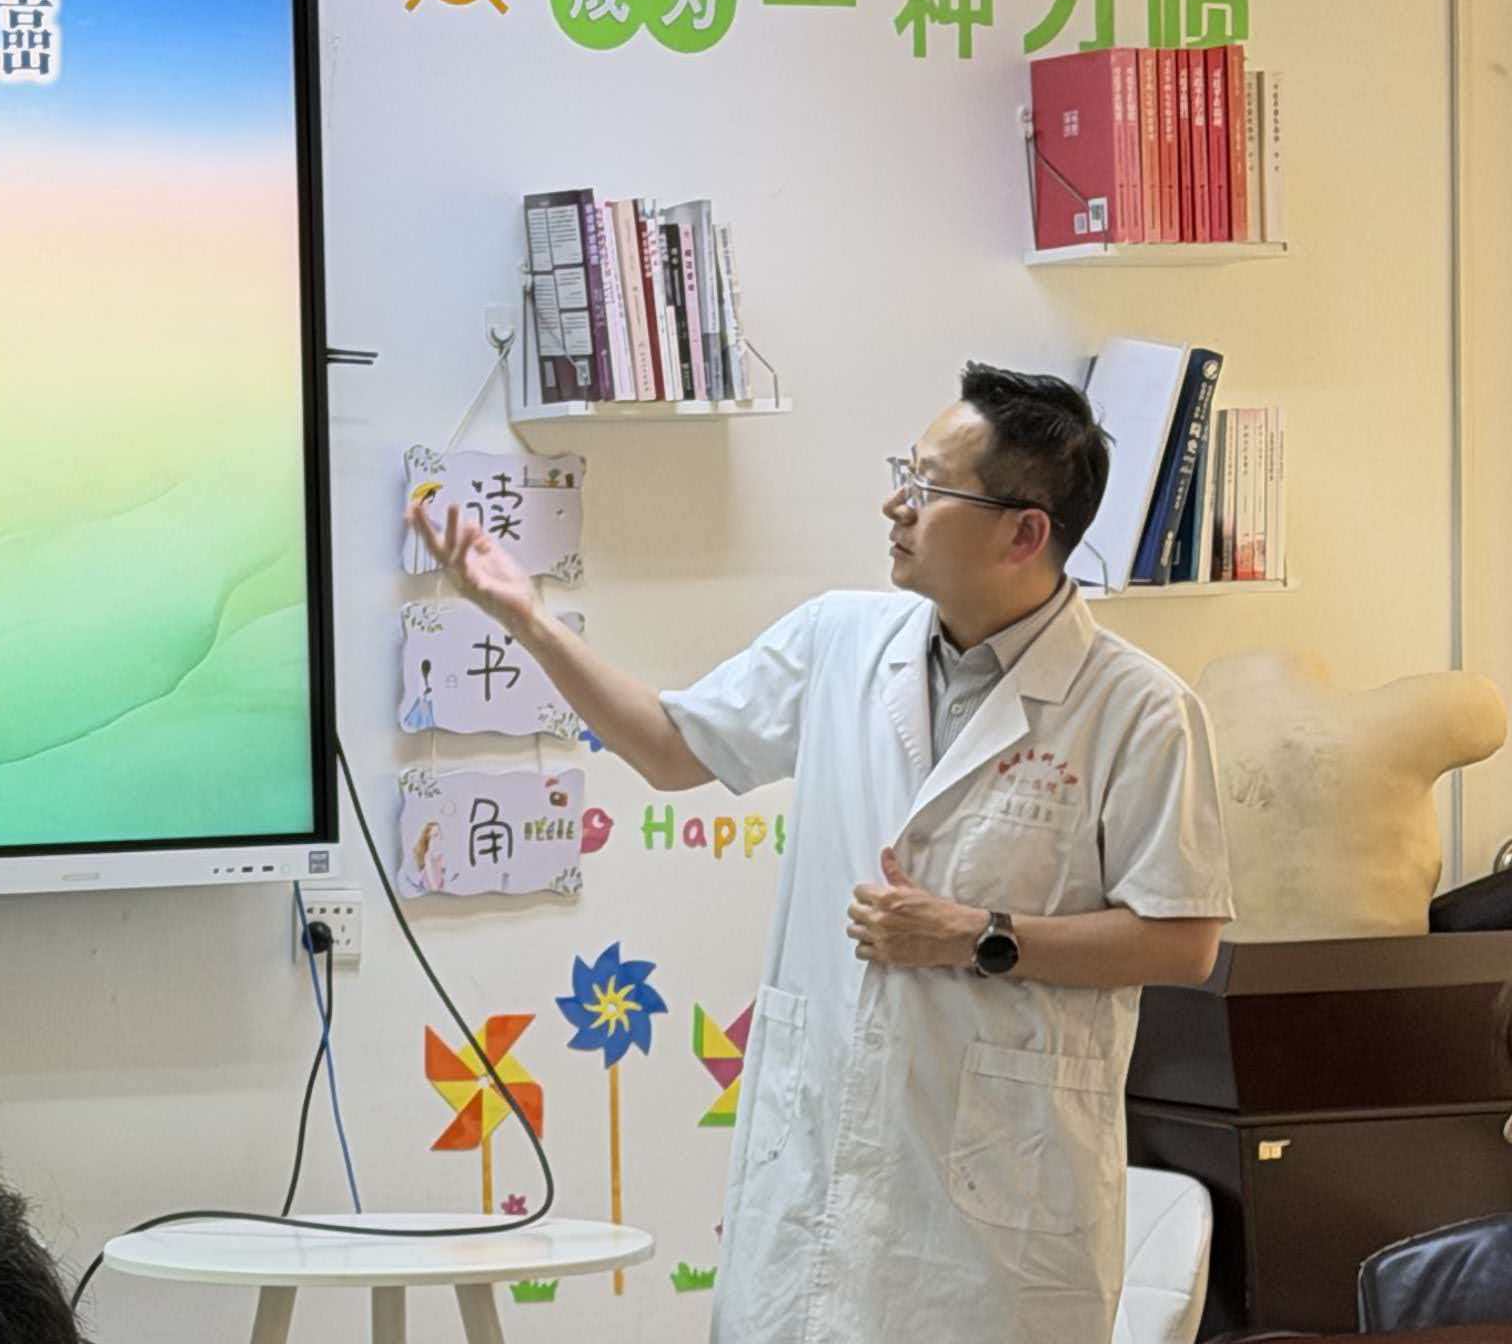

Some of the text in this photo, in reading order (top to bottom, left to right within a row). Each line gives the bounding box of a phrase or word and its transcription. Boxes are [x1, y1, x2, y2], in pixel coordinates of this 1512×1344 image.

[466, 472, 523, 540] 读
[466, 633, 522, 701] 书
[469, 798, 514, 867] 角
